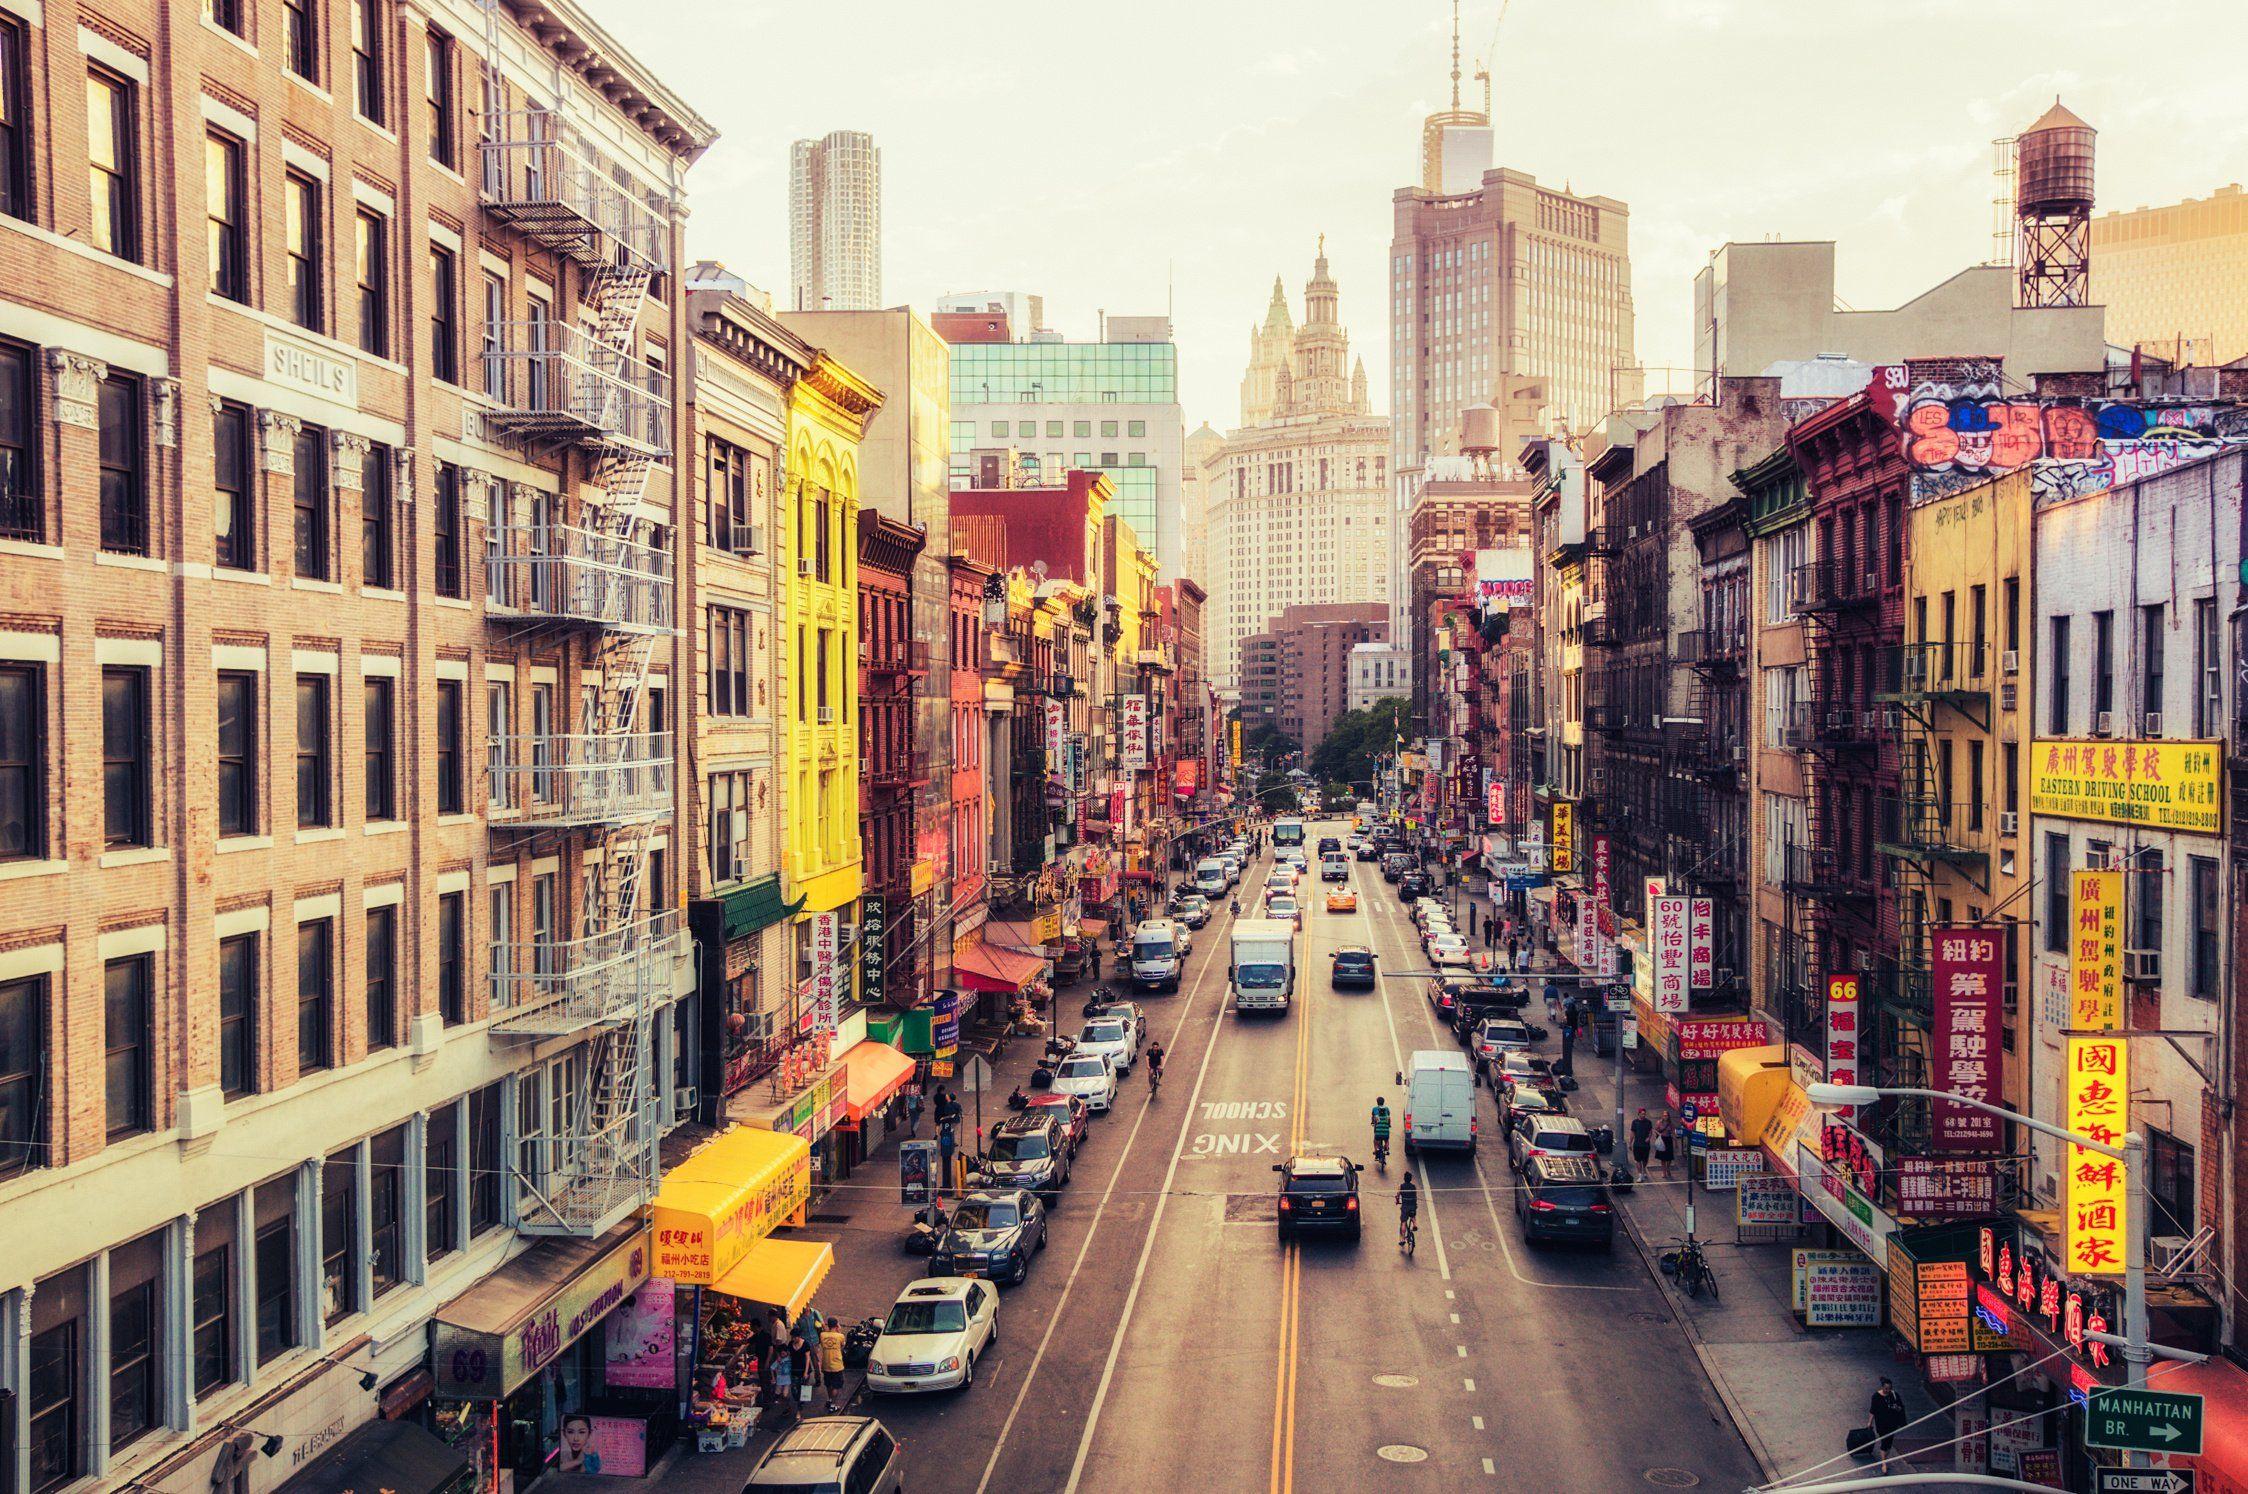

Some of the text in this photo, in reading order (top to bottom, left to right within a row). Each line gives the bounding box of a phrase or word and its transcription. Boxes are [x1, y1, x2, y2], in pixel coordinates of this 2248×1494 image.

[272, 344, 345, 392] SHEILS
[1125, 699, 1144, 755] 福華傢俬
[2046, 745, 2161, 781] 廣州駕駛學校
[2040, 778, 2171, 803] EASTERN DRIVING SCHOOL
[1555, 805, 1570, 869] 華美商場
[866, 902, 883, 998] 欣榕服務中心
[1942, 939, 1993, 962] 紐約
[2079, 878, 2100, 1023] 廣州駕駛學
[817, 914, 832, 1024] 香港中醫骨傷科診所
[1830, 981, 1857, 999] 66
[1948, 972, 1987, 1109] 第一駕駛學校
[1201, 1102, 1287, 1118] SCHOOL
[1194, 1134, 1281, 1156] XING
[1709, 1153, 1761, 1162] 福州大花店
[2076, 1044, 2121, 1268] 國惠海鮮酒家
[661, 1252, 710, 1266] 福州小吃店
[453, 1349, 487, 1384] 69
[2099, 1398, 2192, 1420] MANHATTAN
[2105, 1419, 2129, 1436] BR.
[2111, 1476, 2180, 1490] ONE WAY
